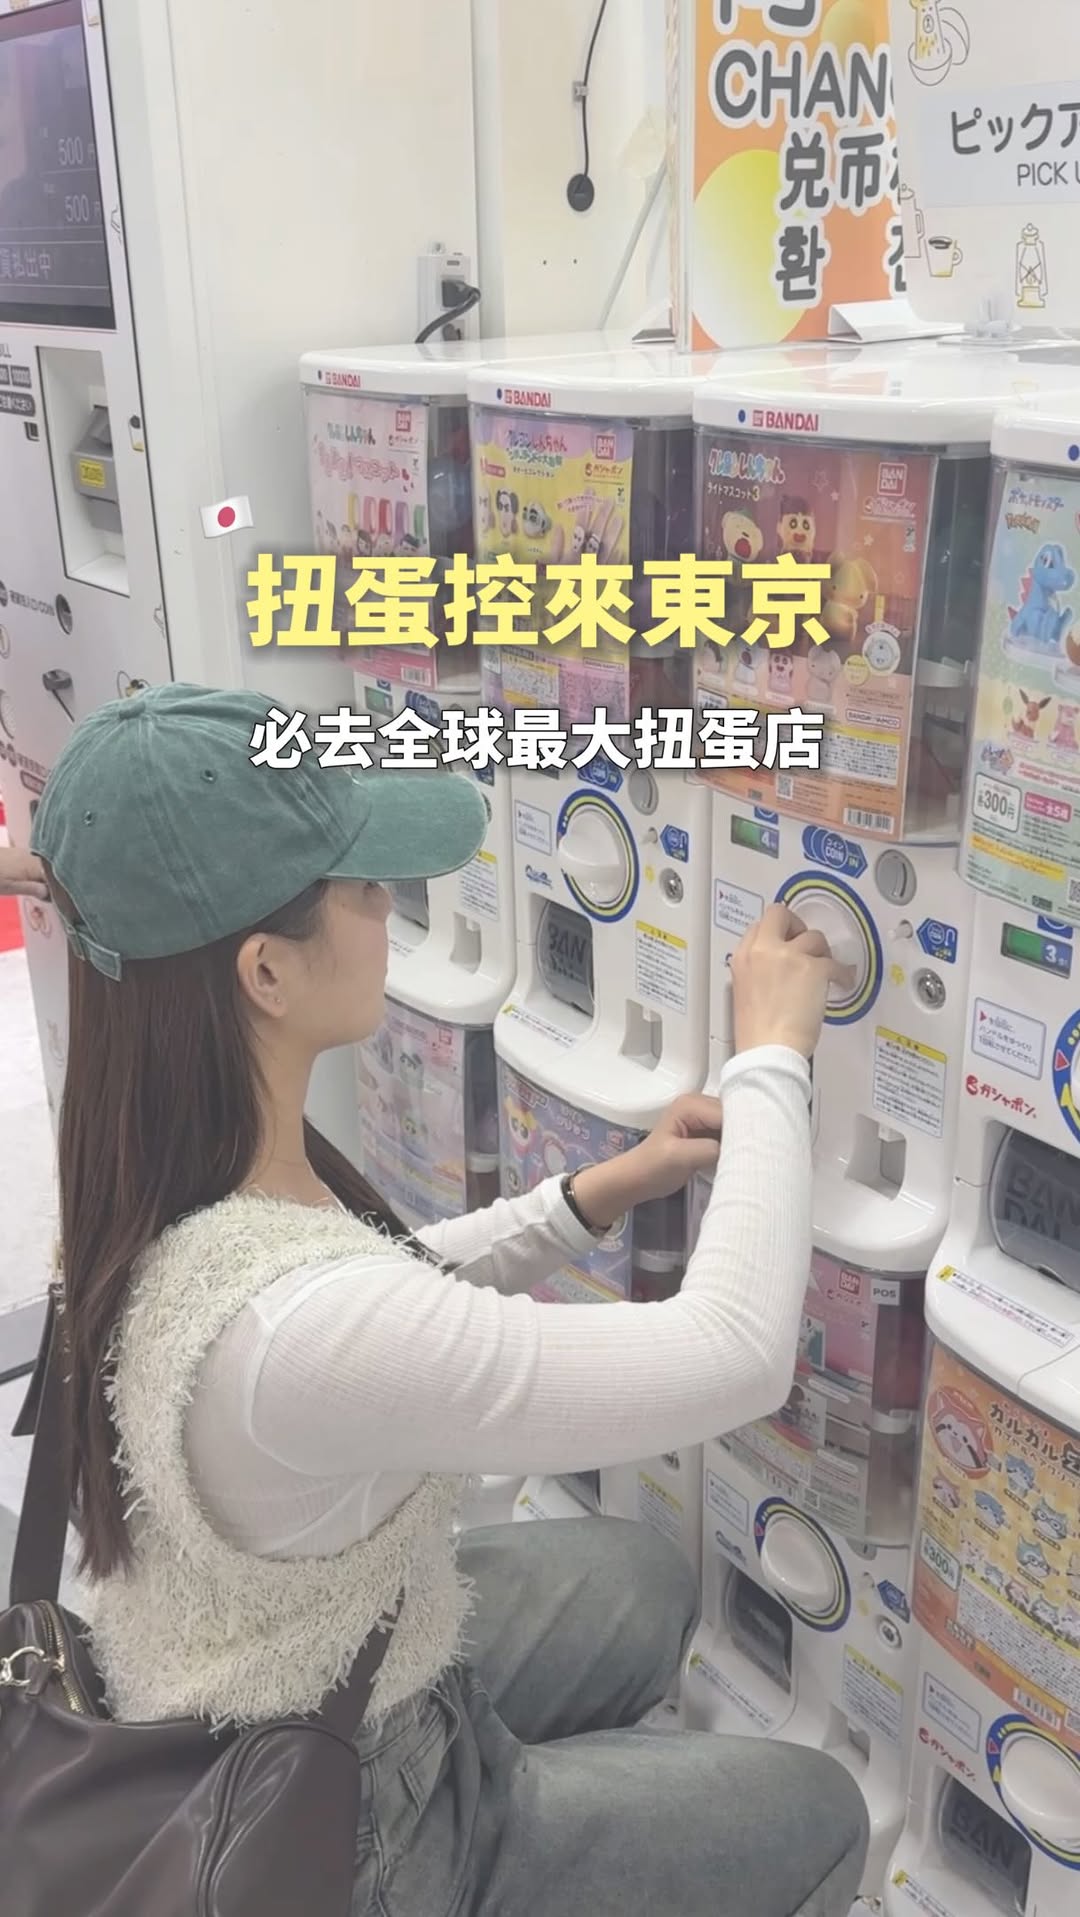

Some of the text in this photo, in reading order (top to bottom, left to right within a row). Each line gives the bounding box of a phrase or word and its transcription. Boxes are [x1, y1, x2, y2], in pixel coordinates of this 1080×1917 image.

[714, 48, 897, 119] CHAN
[58, 136, 84, 166] 500
[1017, 161, 1068, 187] PICK
[65, 194, 90, 222] 500
[332, 373, 361, 388] BANDAI
[513, 390, 551, 408] BANDAI
[766, 411, 819, 431] BANDAI
[881, 467, 904, 480] BAN
[984, 789, 1008, 816] 300
[826, 847, 844, 862] COIN
[1045, 944, 1057, 963] 3
[873, 1287, 897, 1299] POS
